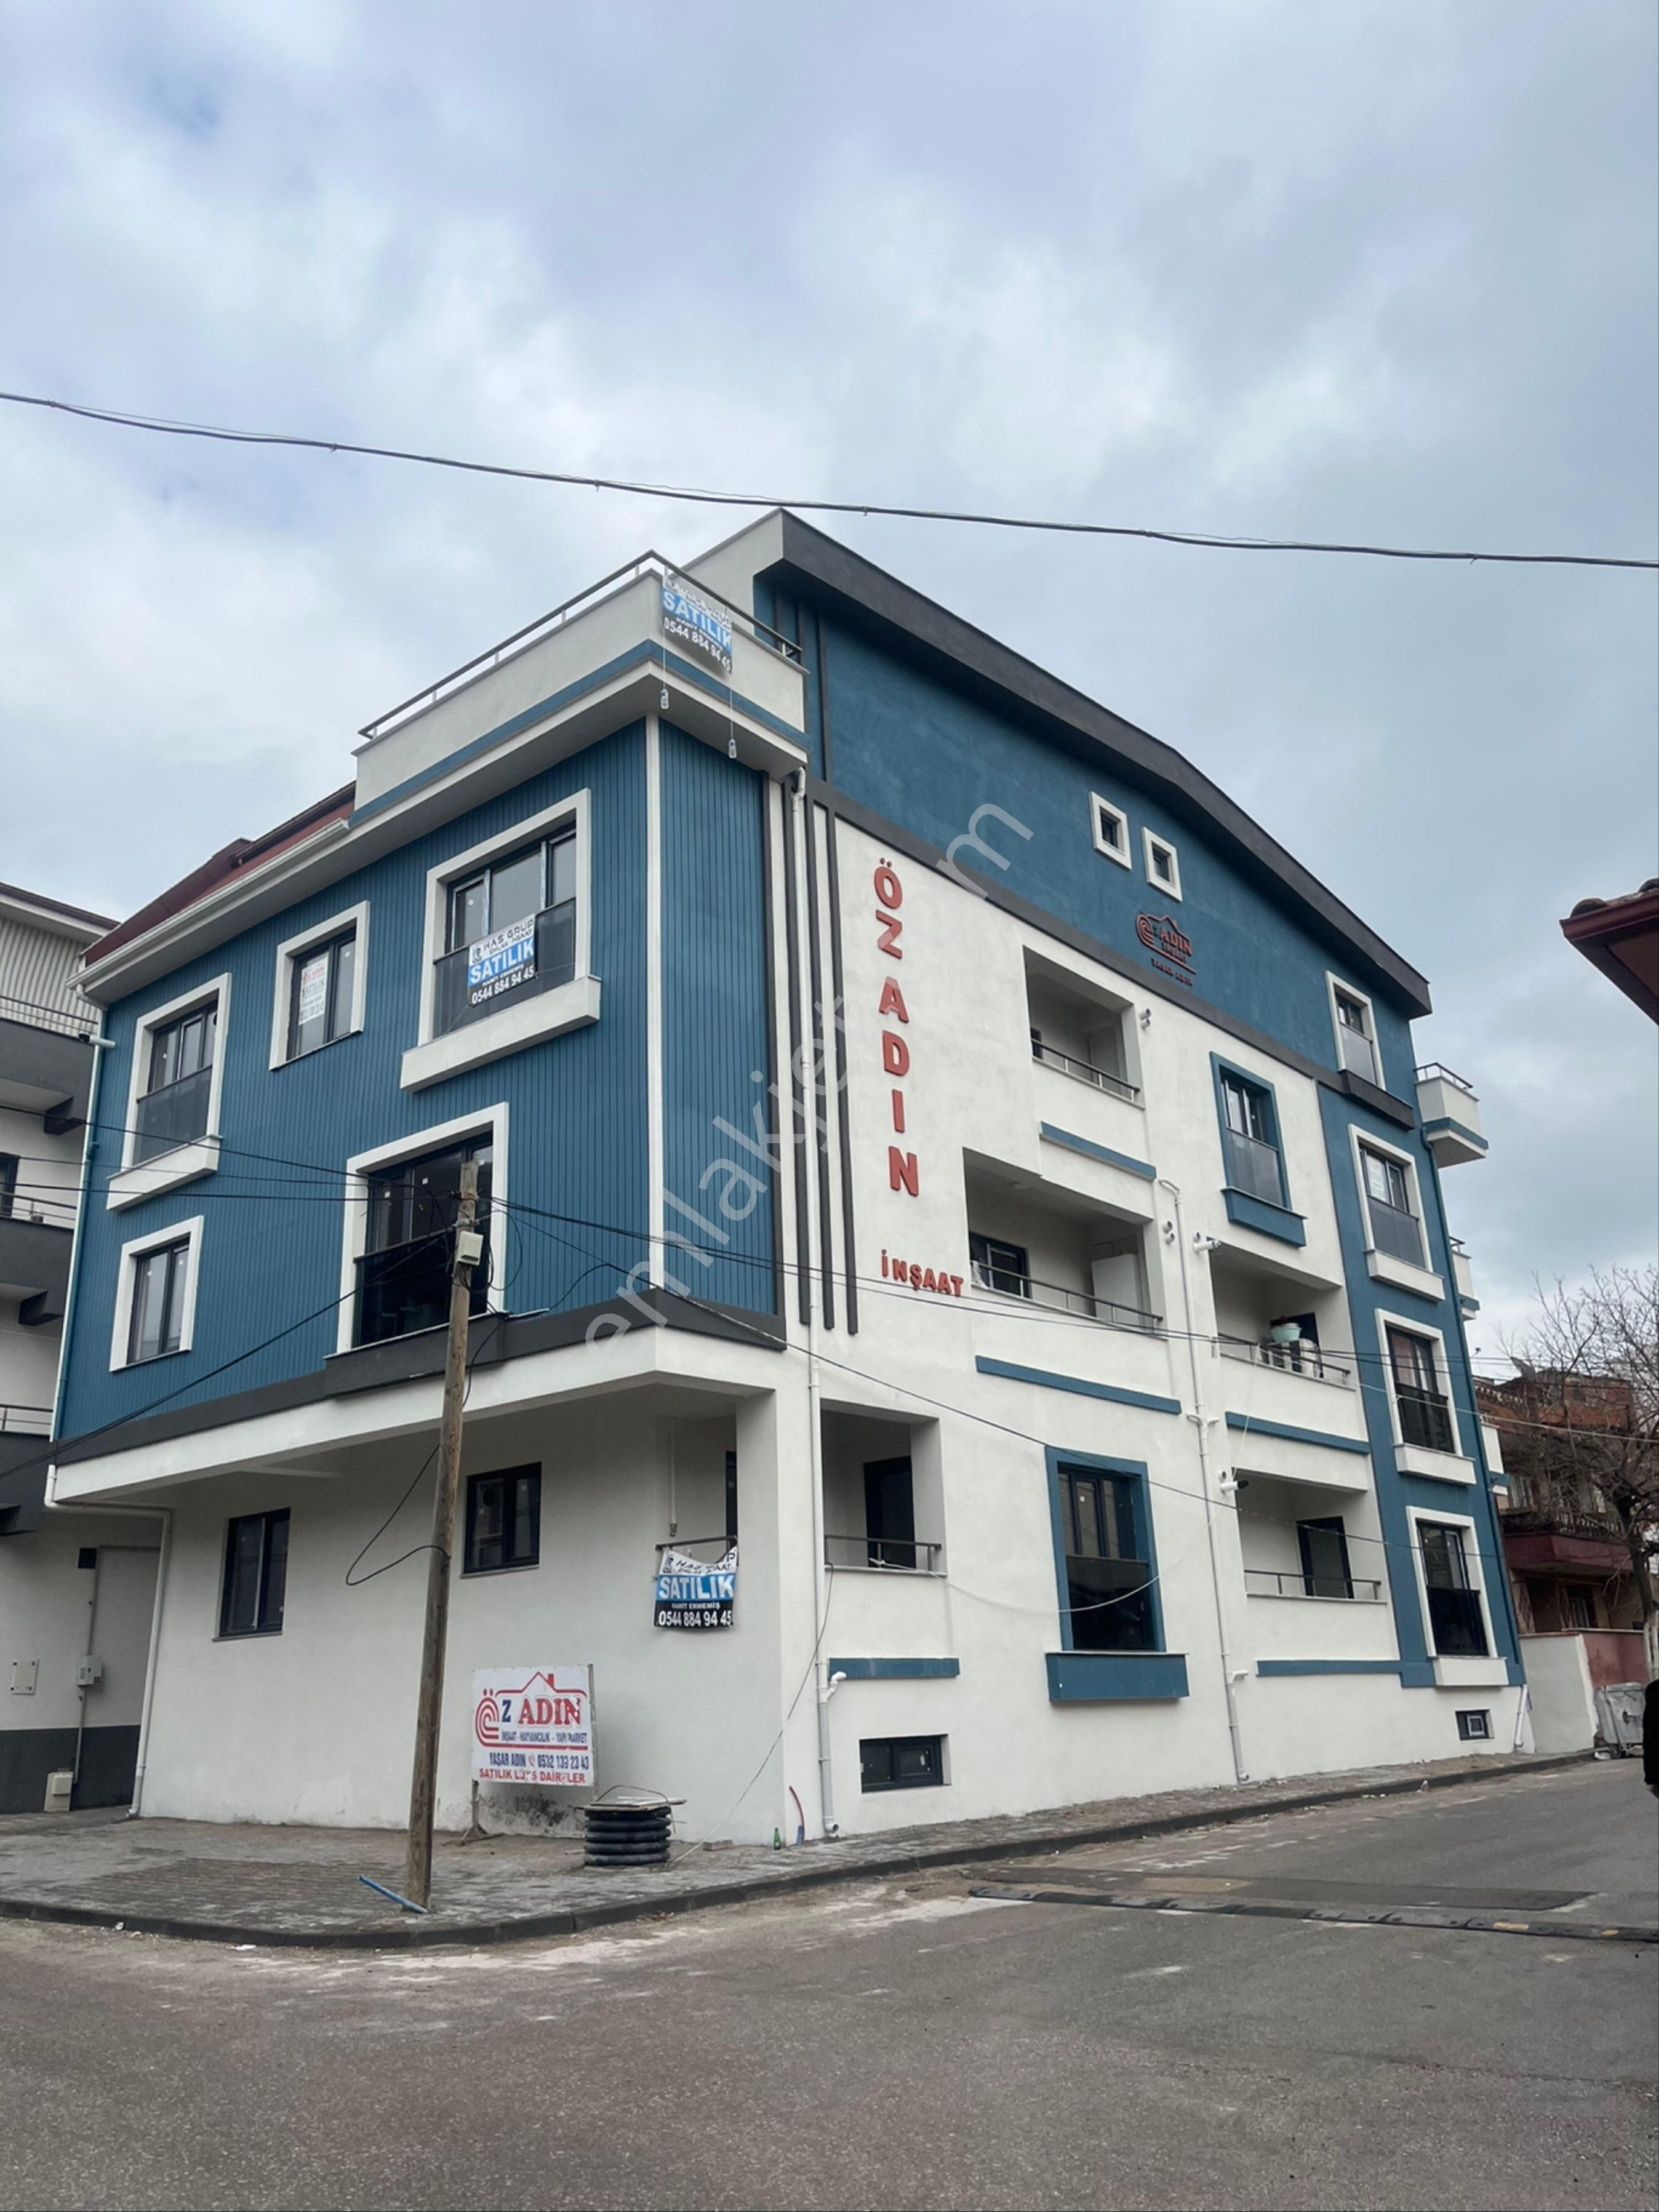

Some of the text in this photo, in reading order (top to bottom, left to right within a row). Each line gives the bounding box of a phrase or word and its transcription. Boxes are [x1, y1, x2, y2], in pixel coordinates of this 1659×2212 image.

[663, 591, 732, 651] SATILIK
[664, 618, 731, 672] 0544 884 94 45
[483, 919, 534, 951] HAS GRUP
[471, 939, 534, 983] SATILIK
[471, 965, 535, 1005] 0544 884 94 45
[881, 1250, 964, 1296] İNŞAAT
[658, 1575, 734, 1599] SATILIK
[658, 1610, 732, 1626] 0544 884 94 45
[518, 1696, 582, 1725] ADIN
[479, 1768, 512, 1779] SATILIK
[489, 1752, 510, 1767] YAŞAR
[511, 1754, 526, 1767] ADIN
[537, 1754, 554, 1768] 0532
